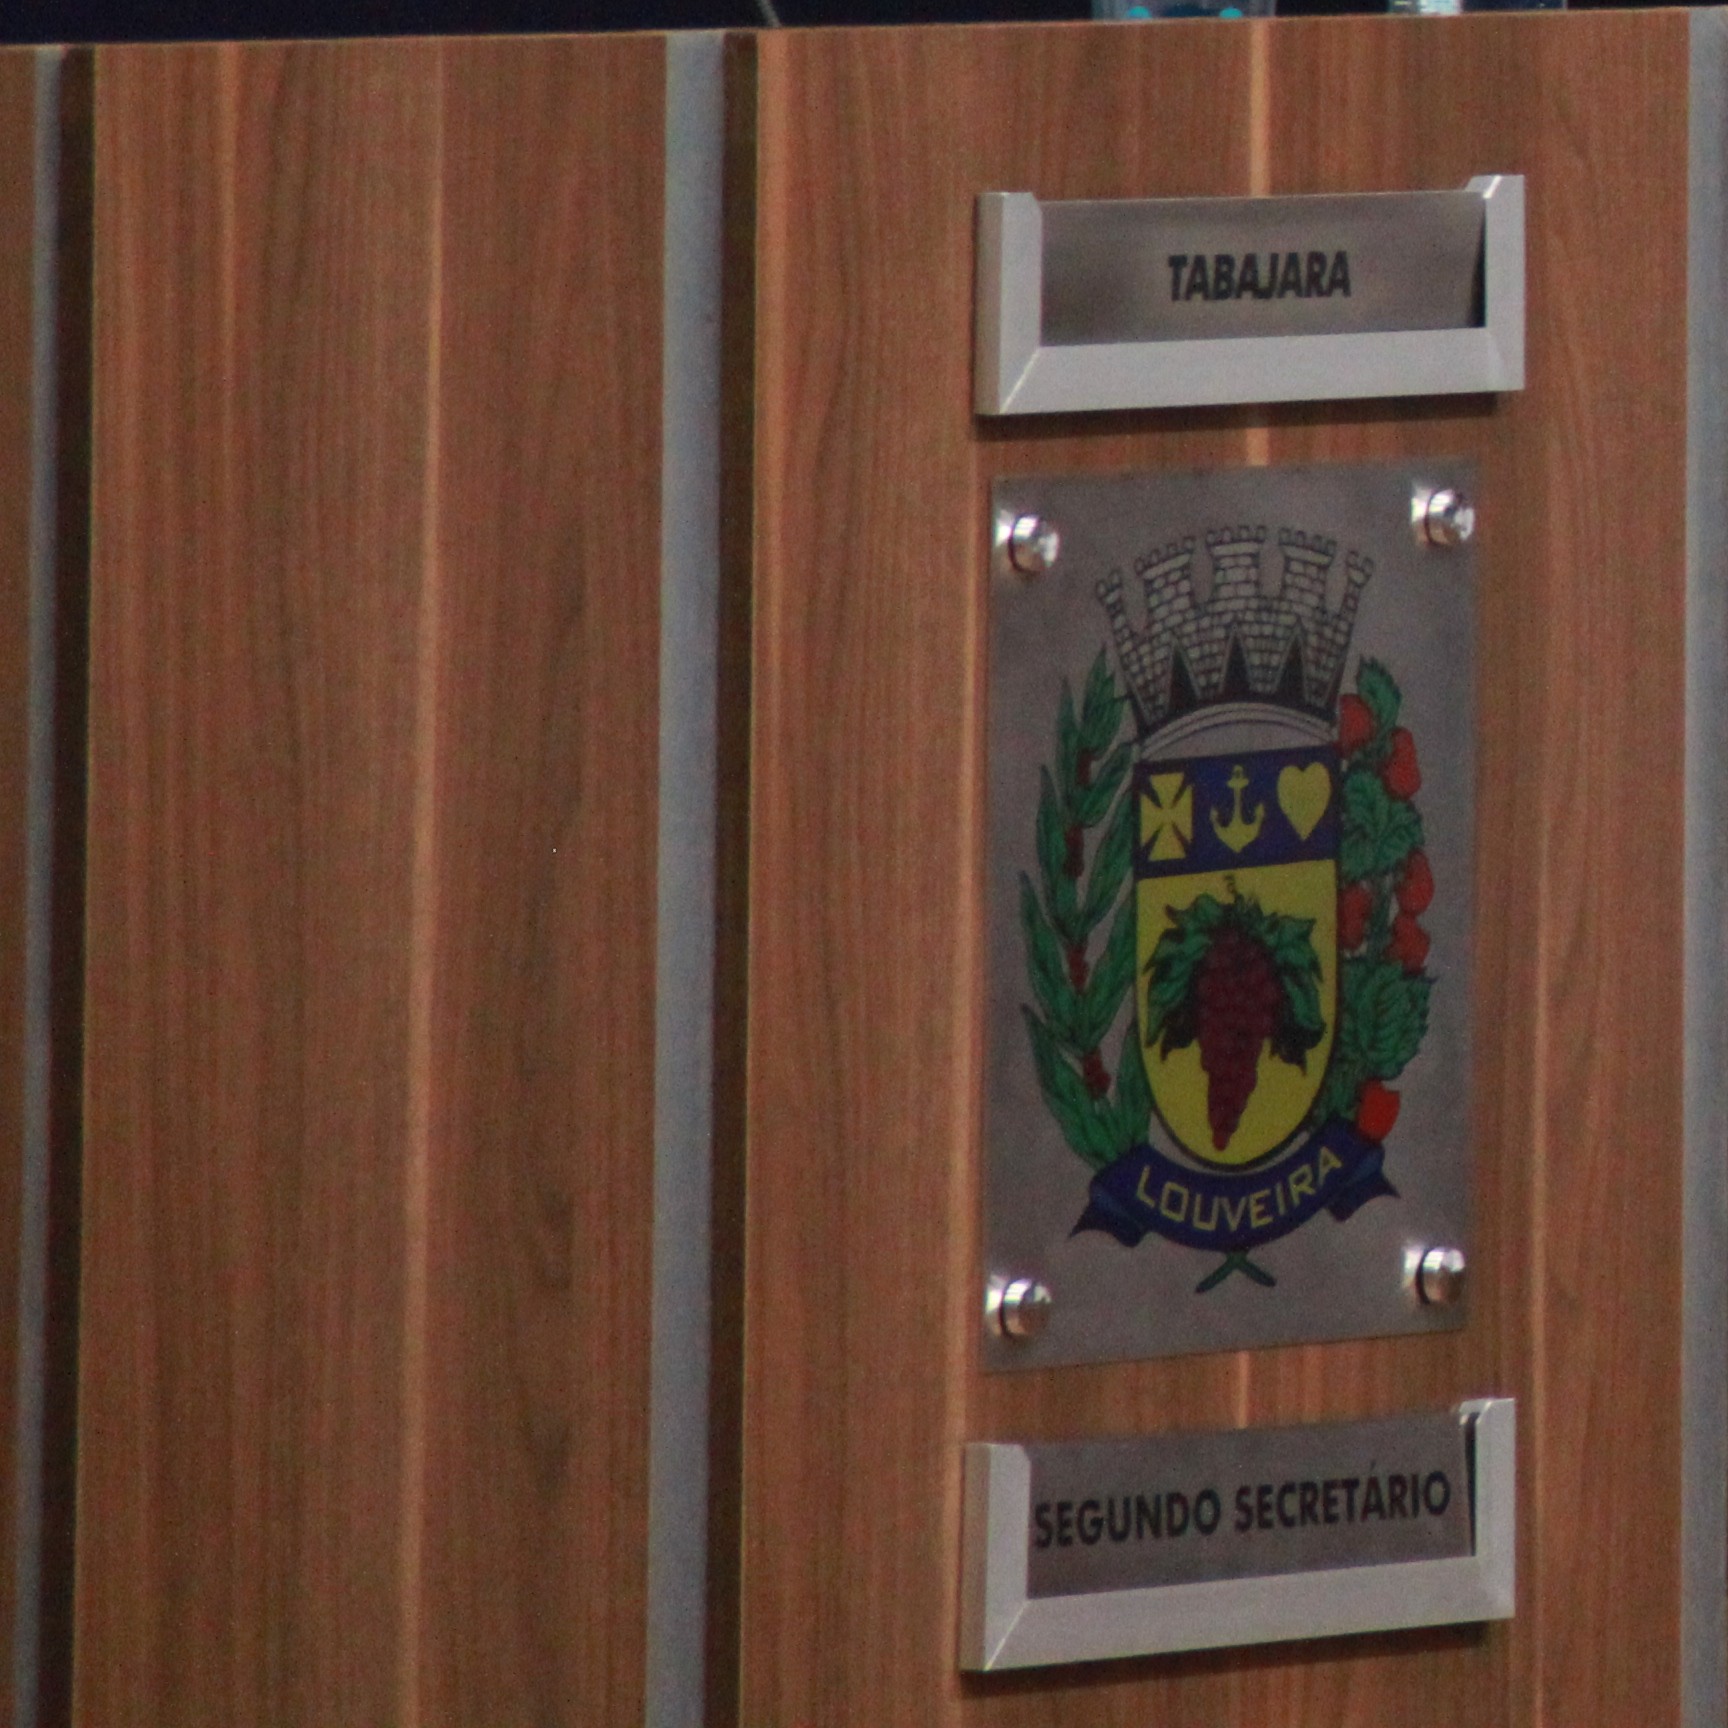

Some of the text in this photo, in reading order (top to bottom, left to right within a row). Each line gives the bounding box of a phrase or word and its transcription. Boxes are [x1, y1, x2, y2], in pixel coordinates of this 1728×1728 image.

[1168, 250, 1352, 302] TABAJARA
[1135, 1145, 1343, 1232] LOUVEIRA
[1034, 1460, 1452, 1548] SEGUNDO SECRETÁRIO
